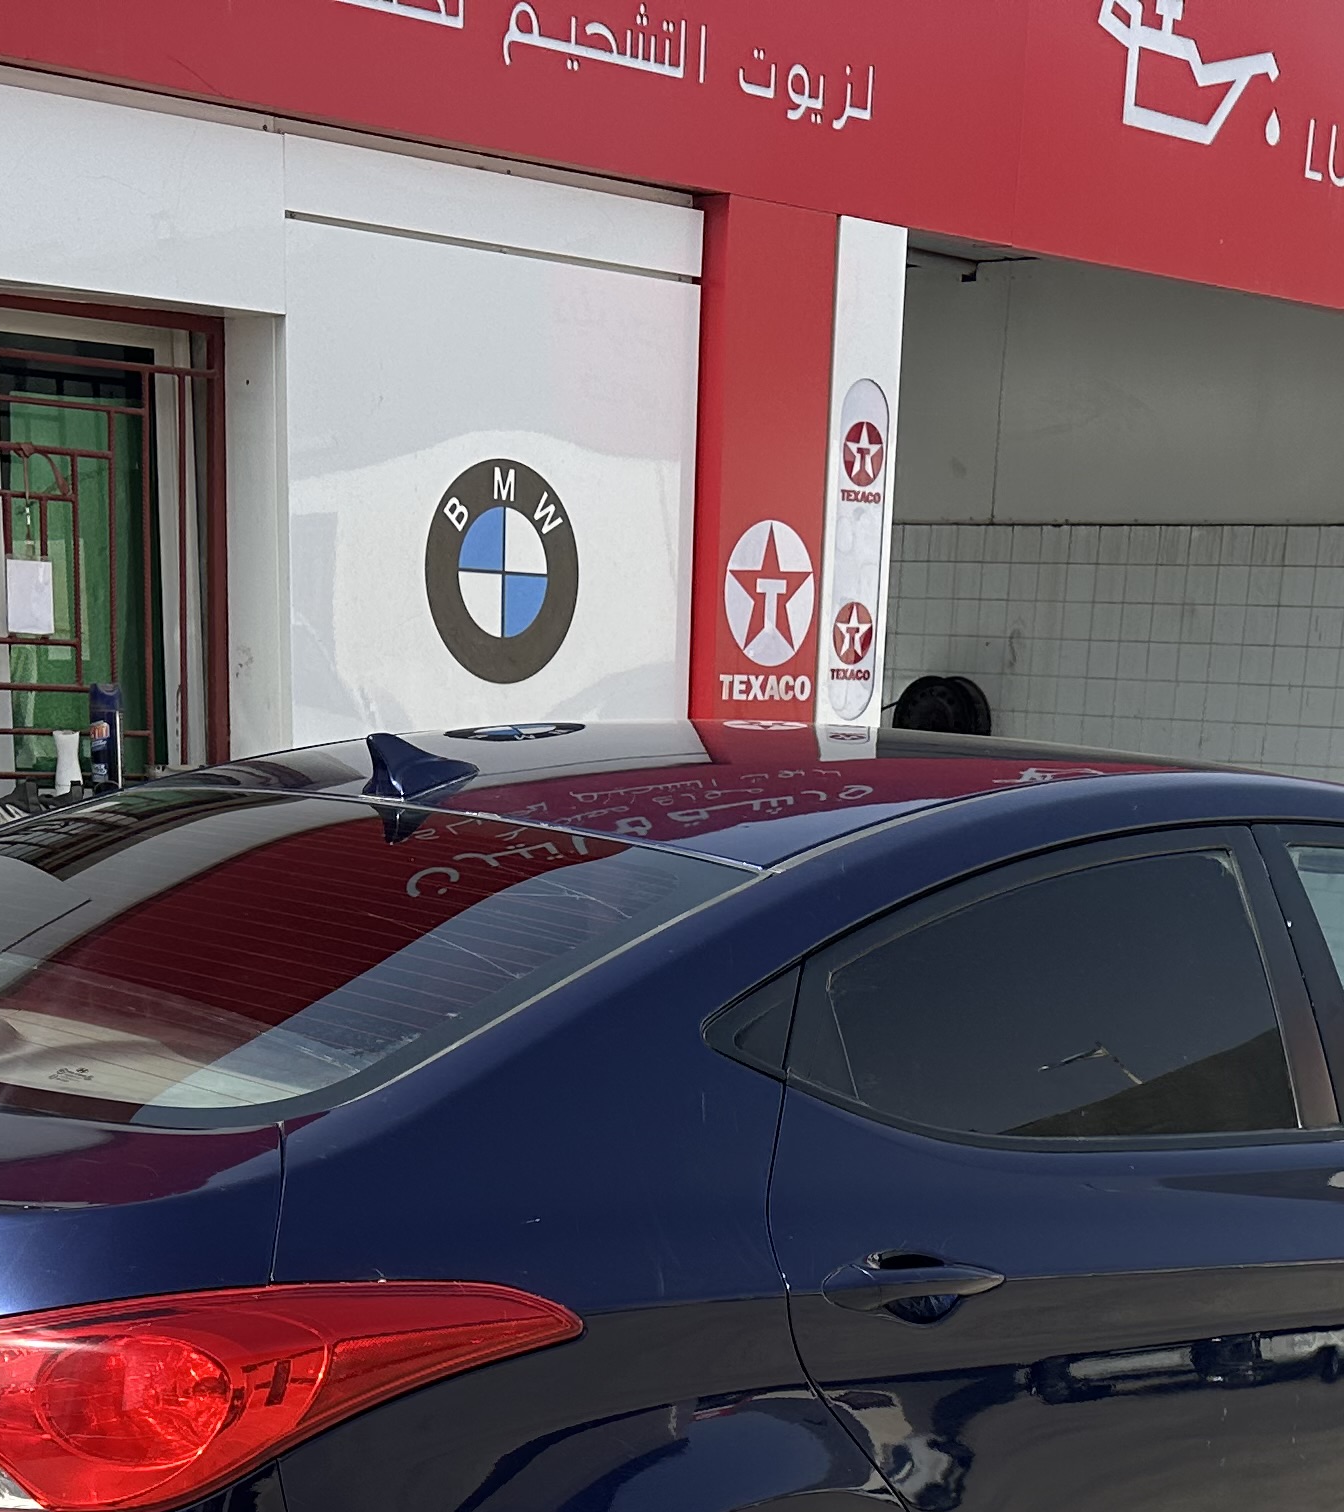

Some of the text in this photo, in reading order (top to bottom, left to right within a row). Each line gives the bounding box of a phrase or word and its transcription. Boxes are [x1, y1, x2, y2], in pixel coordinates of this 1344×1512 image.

[503, 0, 875, 131] لزيوت التشحيم
[840, 488, 882, 504] TEXACO
[830, 668, 871, 681] TEXACO
[719, 674, 811, 701] TEXACO
